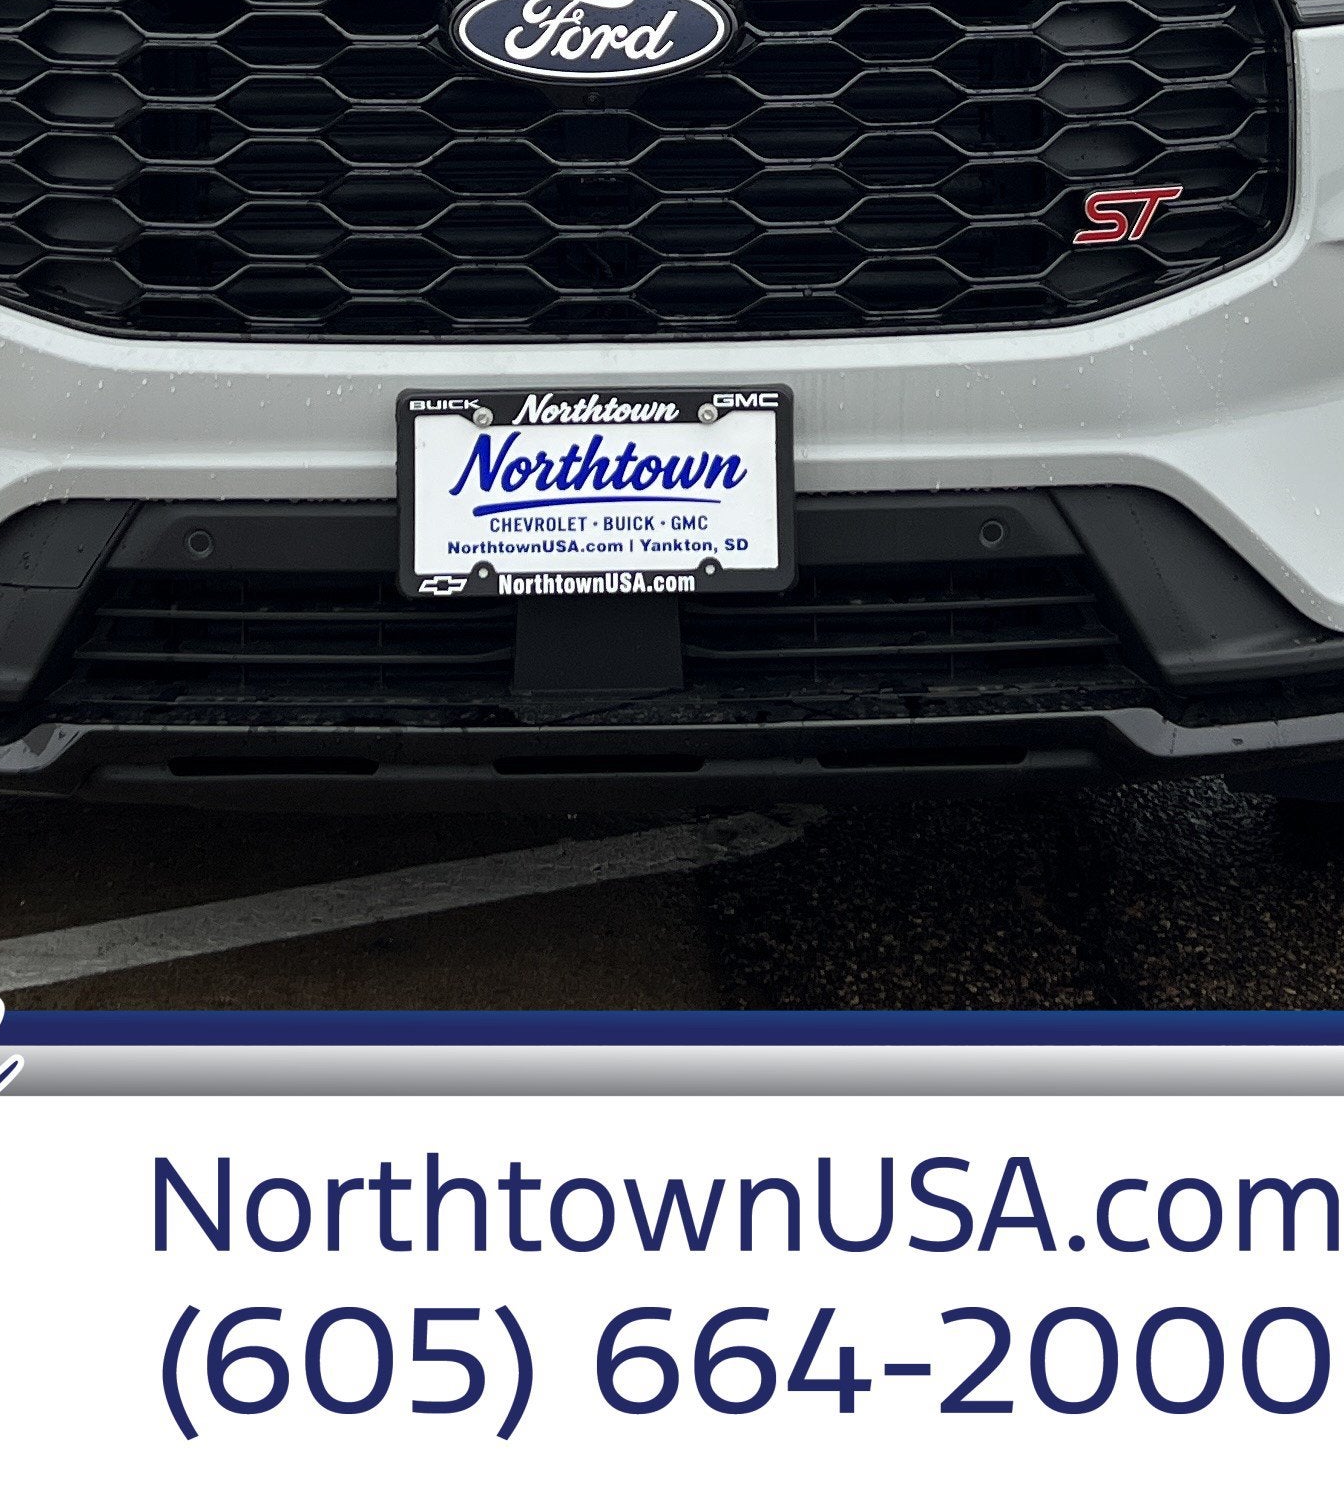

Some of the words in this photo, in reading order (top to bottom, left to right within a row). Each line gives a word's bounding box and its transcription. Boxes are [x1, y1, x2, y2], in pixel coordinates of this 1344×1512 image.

[1073, 186, 1183, 244] ST
[409, 399, 479, 411] BUICK
[512, 393, 680, 425] Northtown
[713, 392, 779, 408] GMC
[449, 431, 748, 496] Northtown
[489, 516, 587, 532] CHEVROLET
[603, 515, 655, 531] BUICK
[671, 515, 709, 531] GMC
[447, 540, 623, 555] NorthtownUSA.com
[640, 539, 719, 555] Yankton,
[724, 538, 749, 552] SD
[498, 573, 696, 595] NorthtownUSA.com
